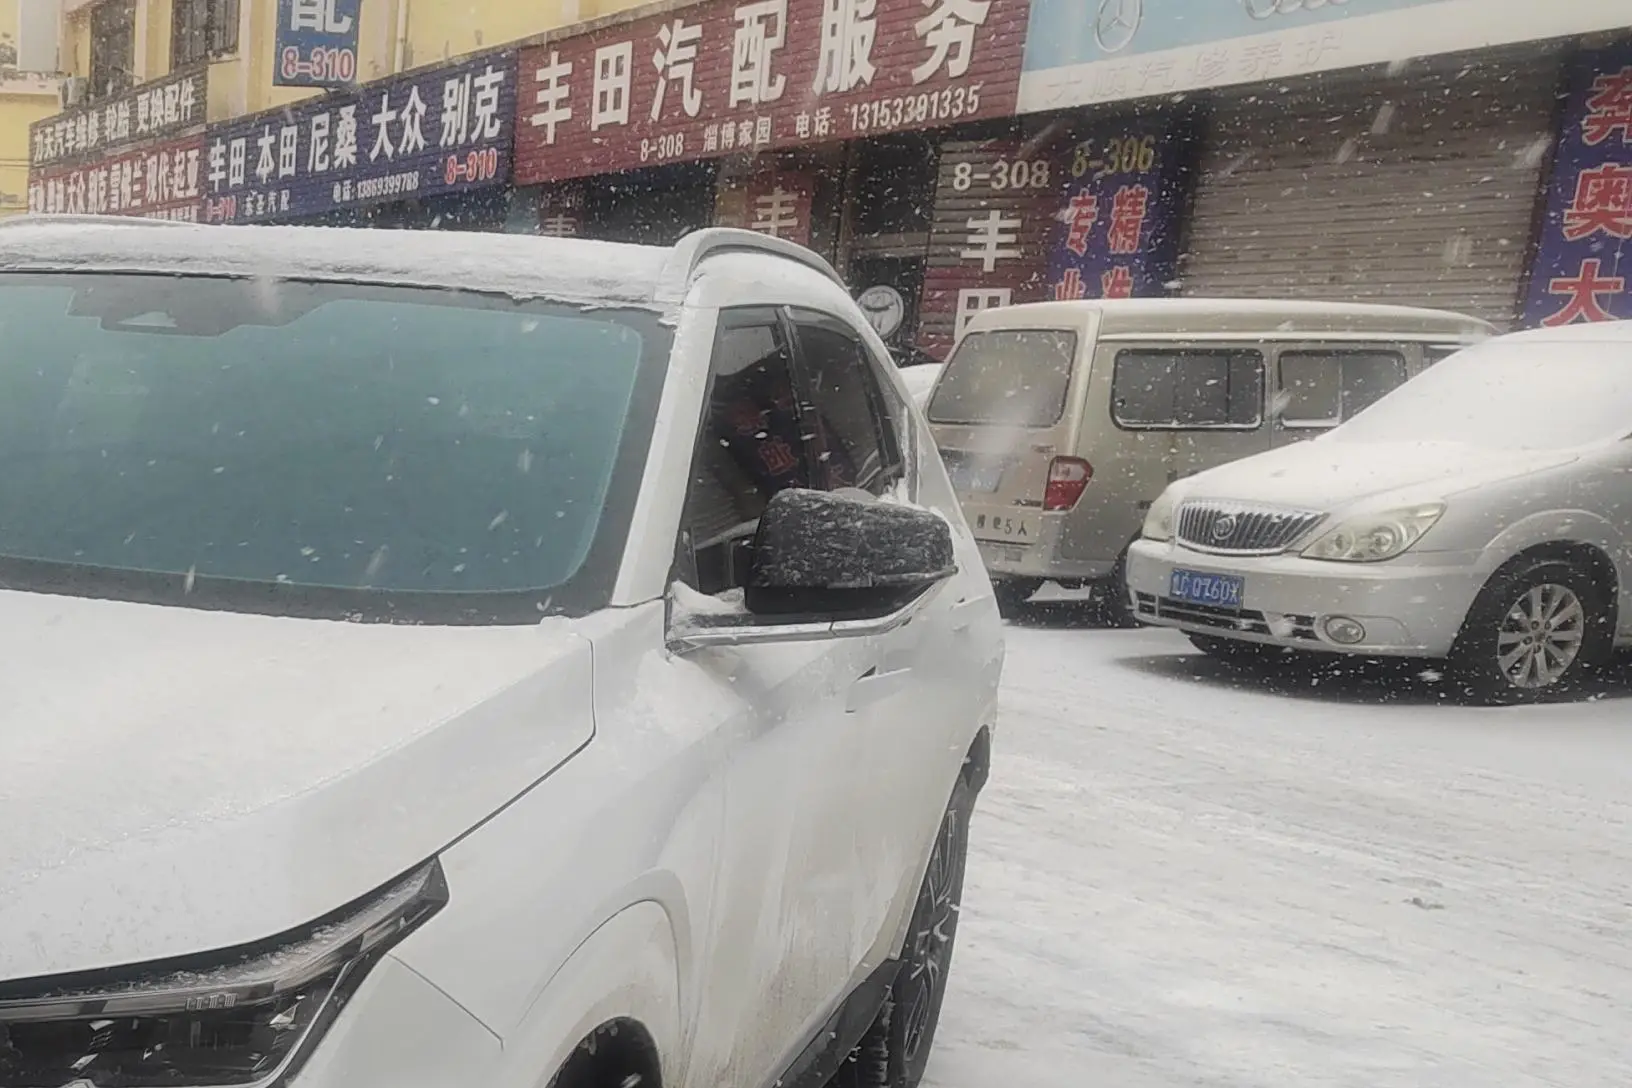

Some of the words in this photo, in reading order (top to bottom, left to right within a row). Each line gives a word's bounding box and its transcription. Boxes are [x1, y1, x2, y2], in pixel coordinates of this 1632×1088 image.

[281, 46, 355, 82] 8-310
[529, 0, 991, 145] 丰田汽配服务
[208, 137, 247, 193] 丰田
[256, 124, 298, 185] 本田
[307, 104, 357, 173] 尼桑
[370, 85, 427, 163] 大众
[439, 66, 505, 148] 别克
[640, 132, 684, 163] 8-308
[444, 148, 498, 184] 8-310
[953, 159, 1051, 192] 8-308
